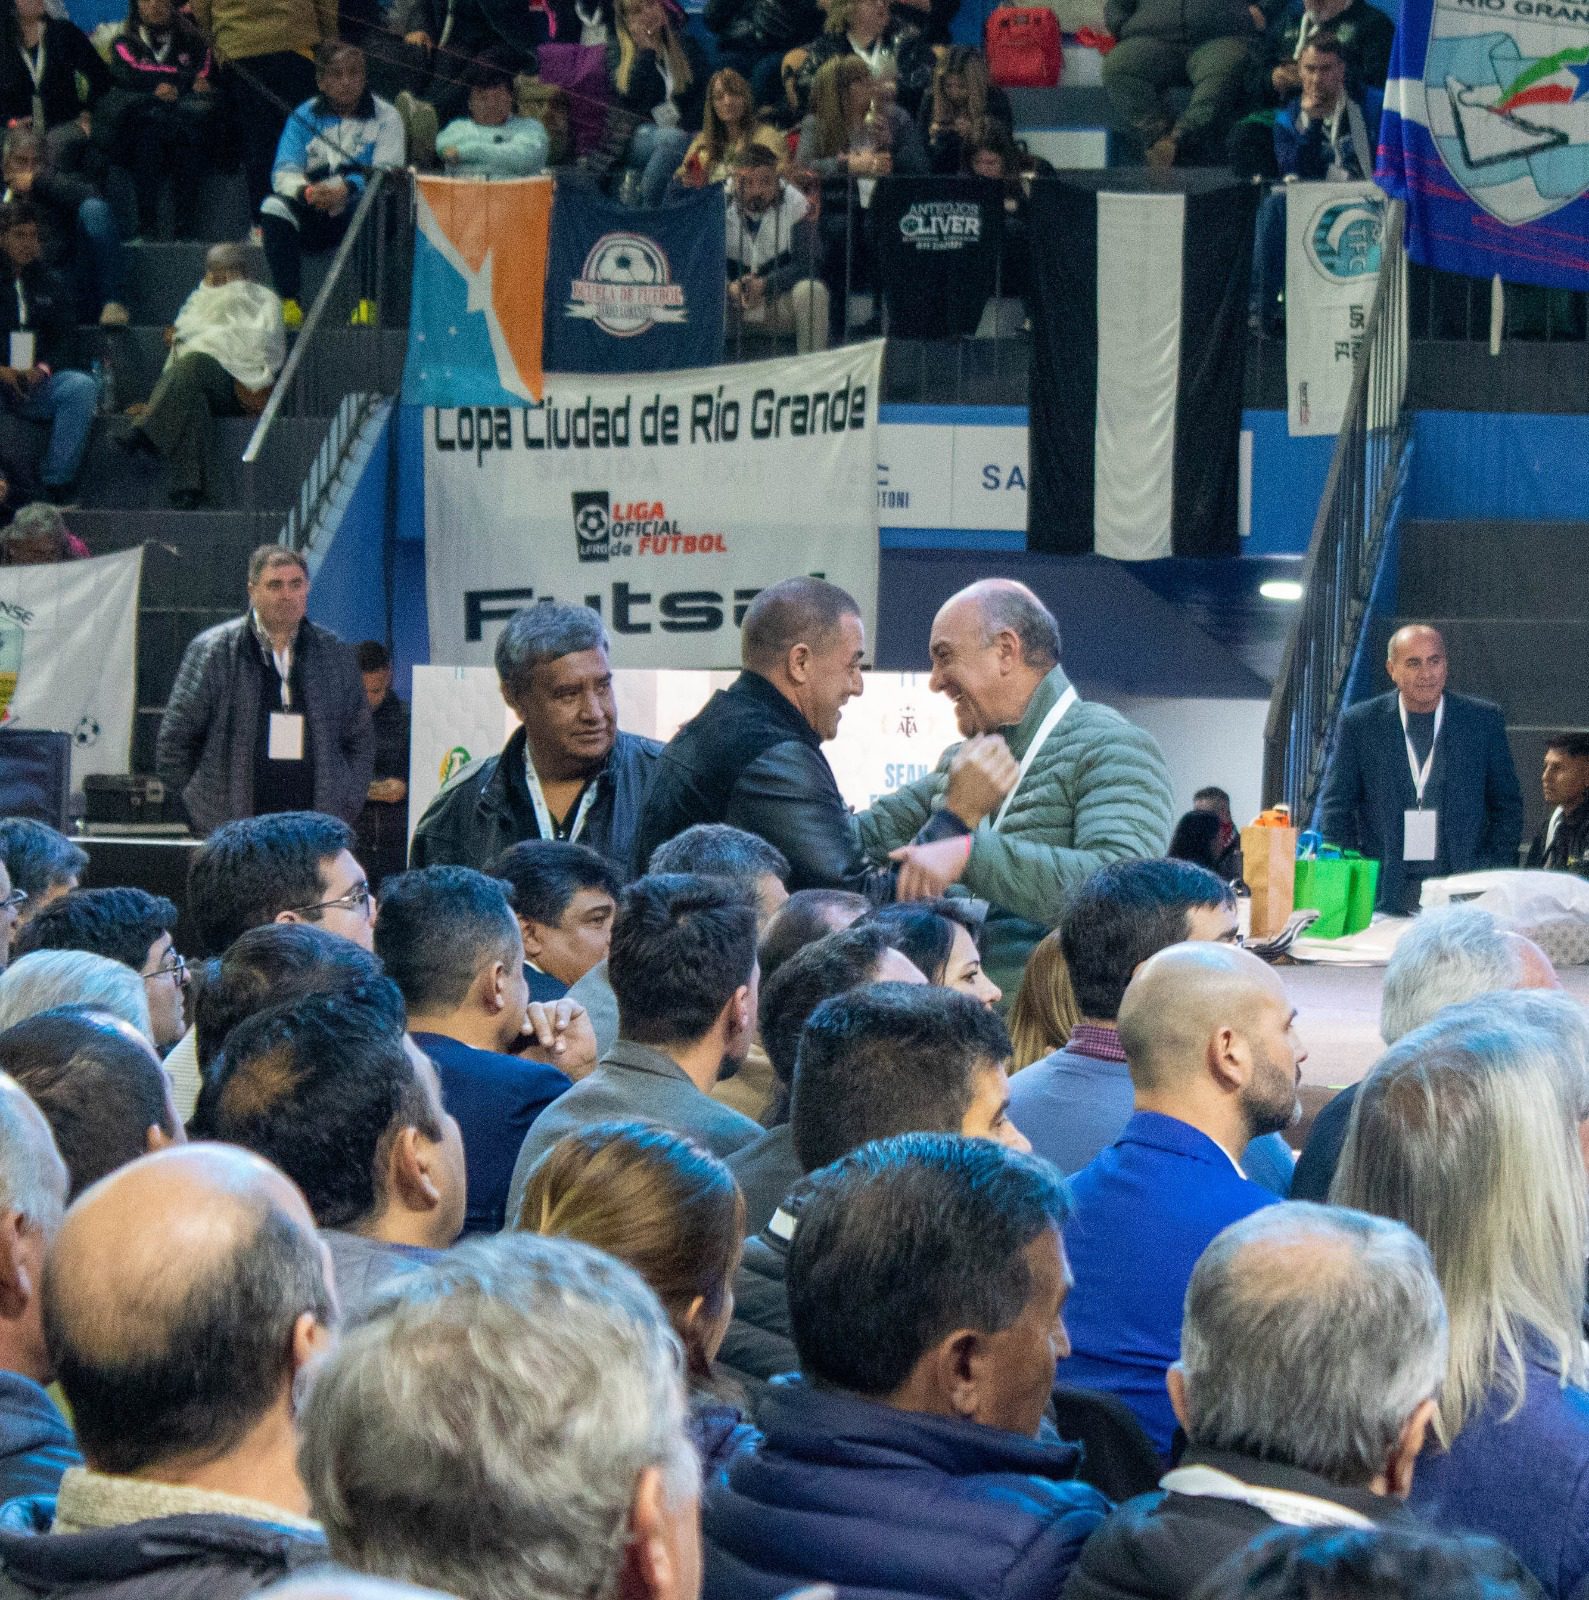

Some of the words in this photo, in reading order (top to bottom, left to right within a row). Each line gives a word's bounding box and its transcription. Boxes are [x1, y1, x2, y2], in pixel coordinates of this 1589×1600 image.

[900, 214, 980, 236] OLIVER
[434, 406, 512, 468] Copa
[523, 394, 632, 449] Ciudad
[640, 394, 679, 446] de
[690, 385, 739, 444] Río
[751, 375, 866, 441] Grande
[877, 490, 909, 509] TONI
[612, 501, 665, 521] LIGA
[611, 520, 682, 538] OFICIAL
[610, 541, 633, 556] de
[638, 533, 727, 556] FUTBOL
